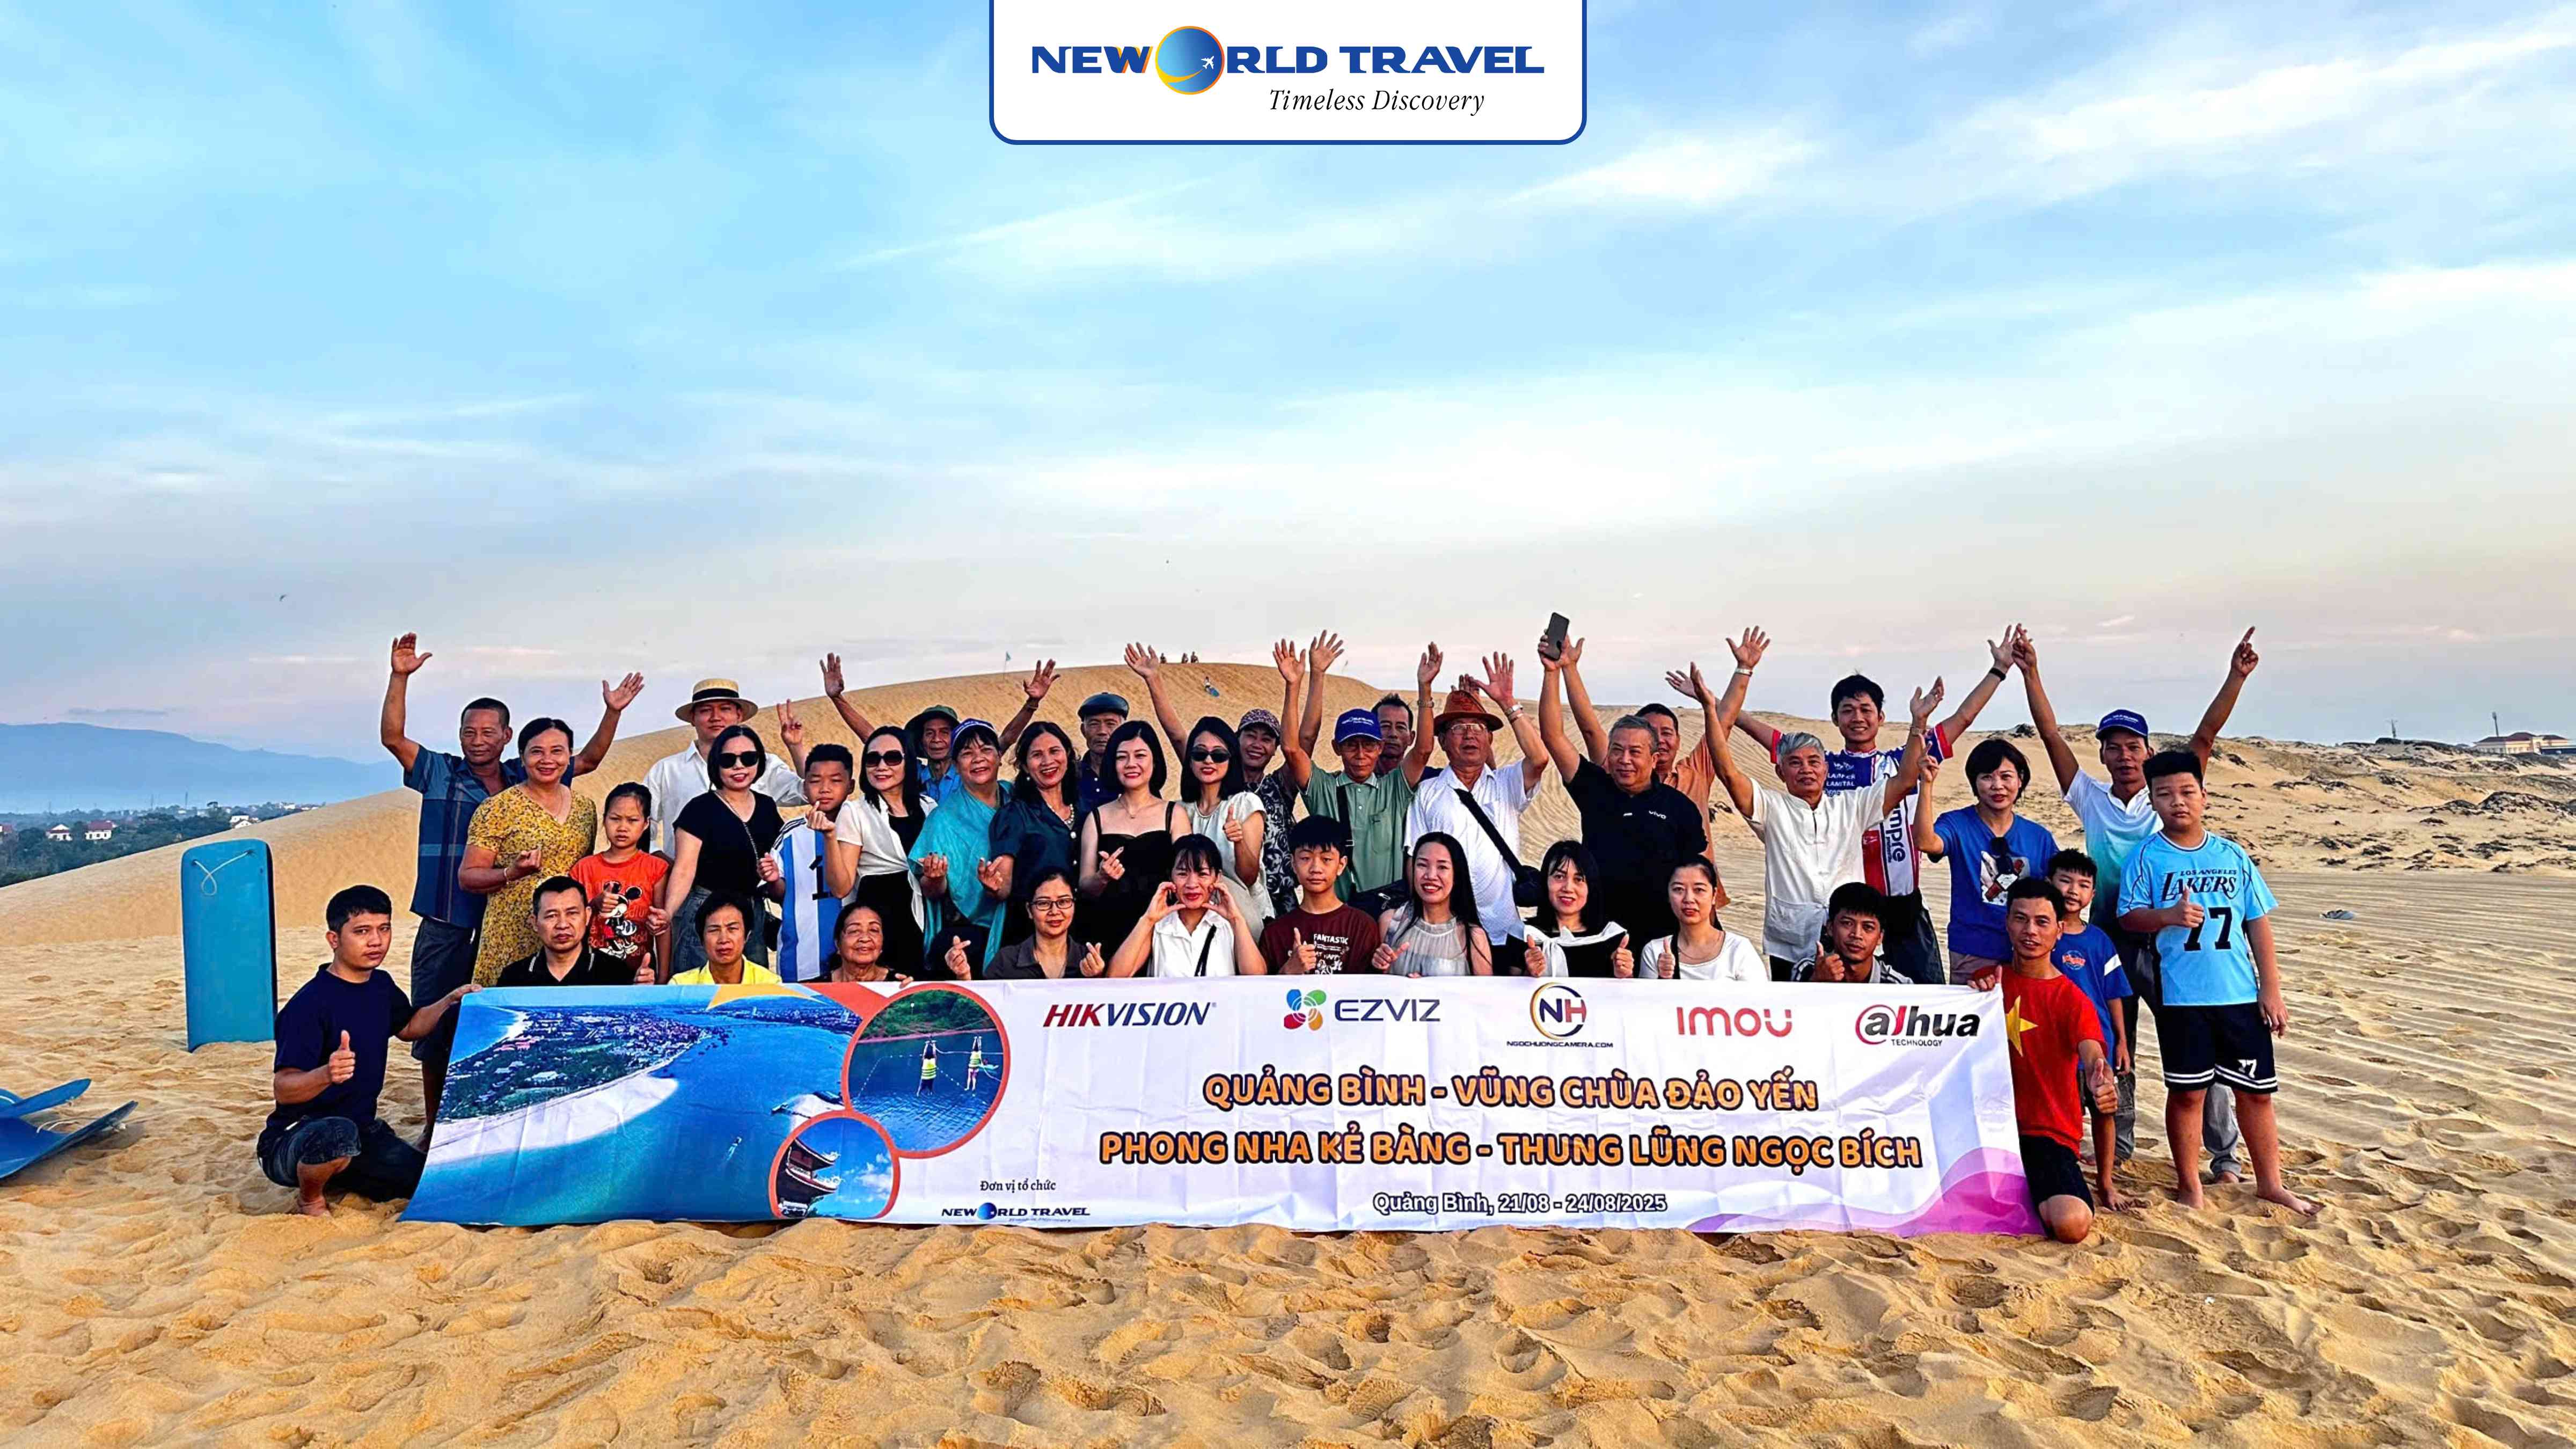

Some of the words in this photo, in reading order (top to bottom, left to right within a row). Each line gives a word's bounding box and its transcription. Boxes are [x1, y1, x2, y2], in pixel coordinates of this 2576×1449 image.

[1885, 809, 1906, 862] mpre
[2162, 872, 2240, 900] LAKERS
[1313, 933, 1349, 945] FANTASTIC
[1335, 999, 1440, 1022] EZVIZ
[1539, 998, 1587, 1023] NH
[1203, 1064, 1333, 1112] QUẢNG
[1339, 1065, 1426, 1106] BÌNH
[1431, 1086, 1447, 1099] -
[1451, 1066, 1555, 1108] VŨNG
[1560, 1069, 1660, 1109] CHÙA
[1664, 1069, 1743, 1110] ĐẢO
[1746, 1065, 1819, 1111] YẾN
[1099, 1131, 1228, 1165] PHONG
[1235, 1131, 1314, 1164] NHA
[1318, 1120, 1365, 1164] KẺ
[1371, 1123, 1471, 1165] BÀNG
[1476, 1144, 1493, 1157] -
[1497, 1133, 1624, 1167] THUNG
[1629, 1125, 1727, 1167] LŨNG
[1732, 1135, 1834, 1176] NGỌC
[1839, 1127, 1923, 1169] BÍCH
[980, 1180, 1003, 1191] Đơn
[1005, 1179, 1015, 1194] vị
[1018, 1178, 1029, 1191] tổ
[1030, 1179, 1056, 1191] chức
[1030, 1208, 1091, 1216] TRAVEL
[1373, 1191, 1438, 1216] Quảng
[1442, 1191, 1495, 1216] Bình,
[1498, 1192, 1550, 1213] 21/08
[1553, 1201, 1562, 1209] -
[1565, 1193, 1668, 1213] 24/08/2025
